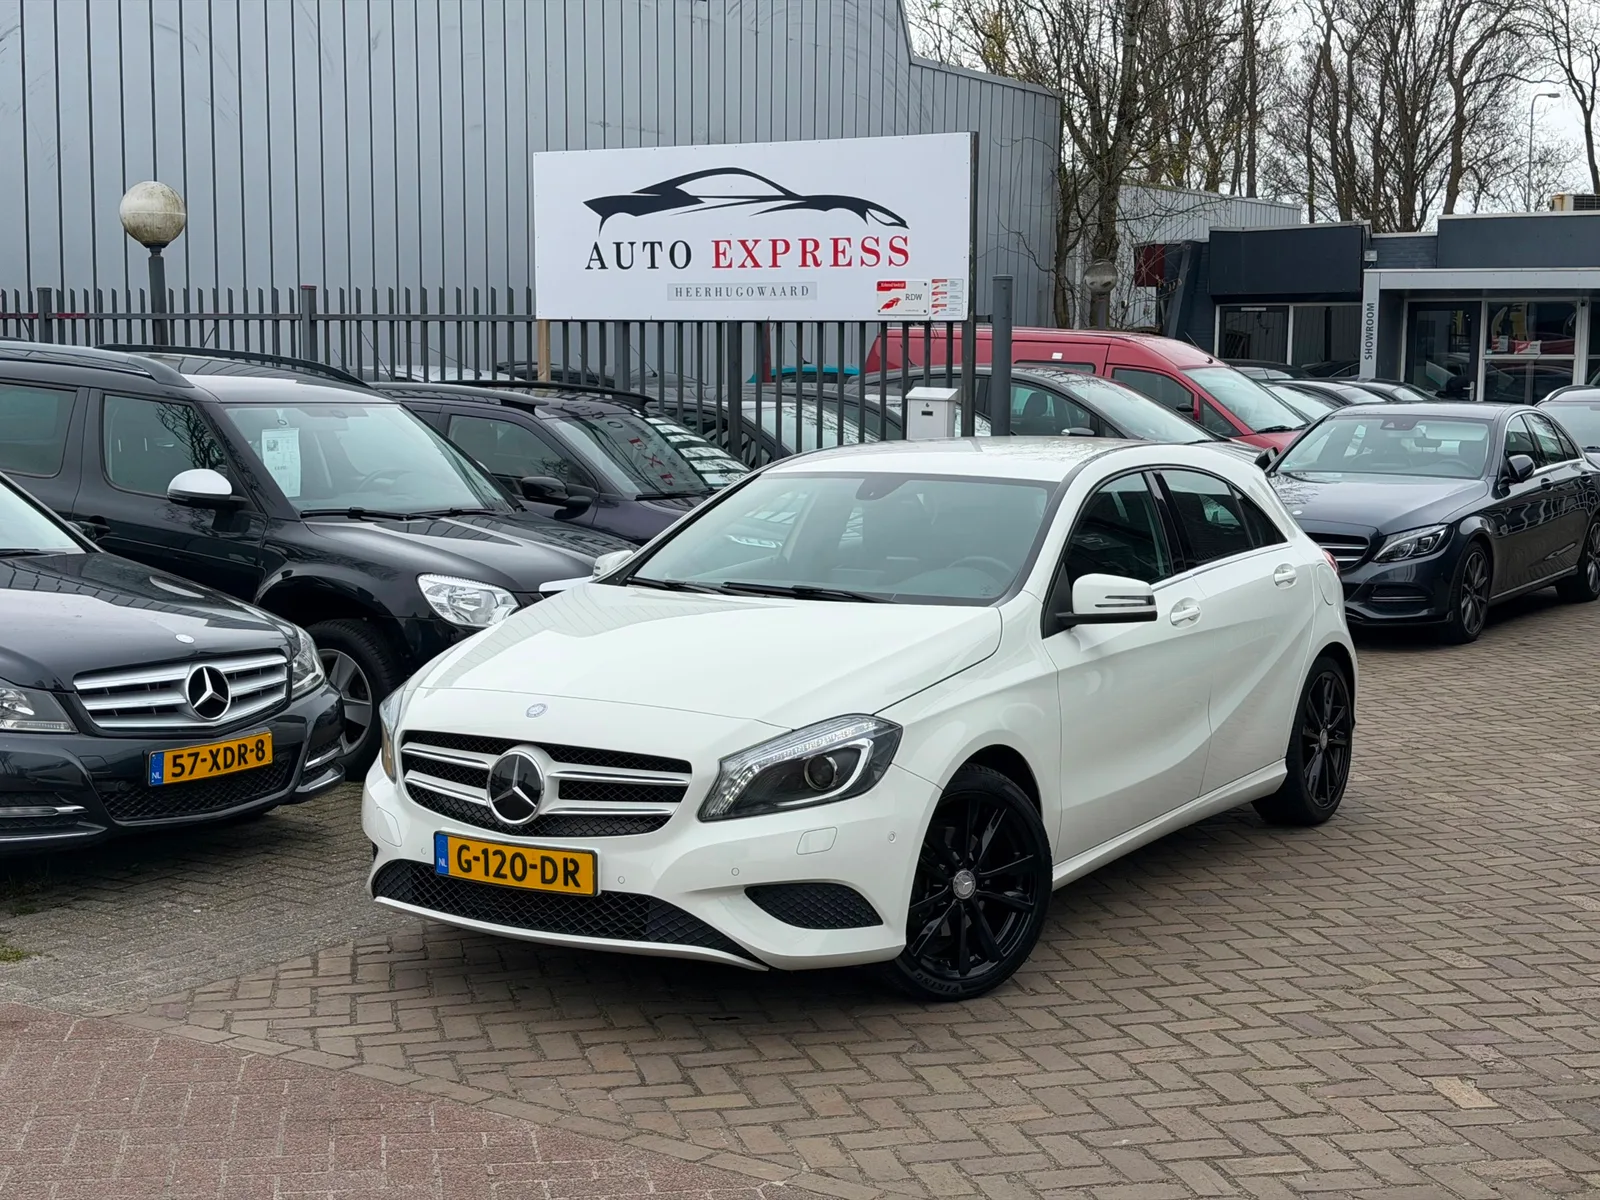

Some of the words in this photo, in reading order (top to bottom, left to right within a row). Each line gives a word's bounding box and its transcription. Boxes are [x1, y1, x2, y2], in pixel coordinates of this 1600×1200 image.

[585, 240, 692, 270] AUTO
[711, 236, 909, 269] EXPRESS
[675, 285, 809, 298] HEERHUGOWAARD
[1364, 302, 1375, 360] SHOWROOM
[171, 739, 266, 778] 57-XDR-8
[151, 772, 162, 780] NL
[438, 857, 448, 868] NL
[456, 844, 581, 888] G-120-DR
